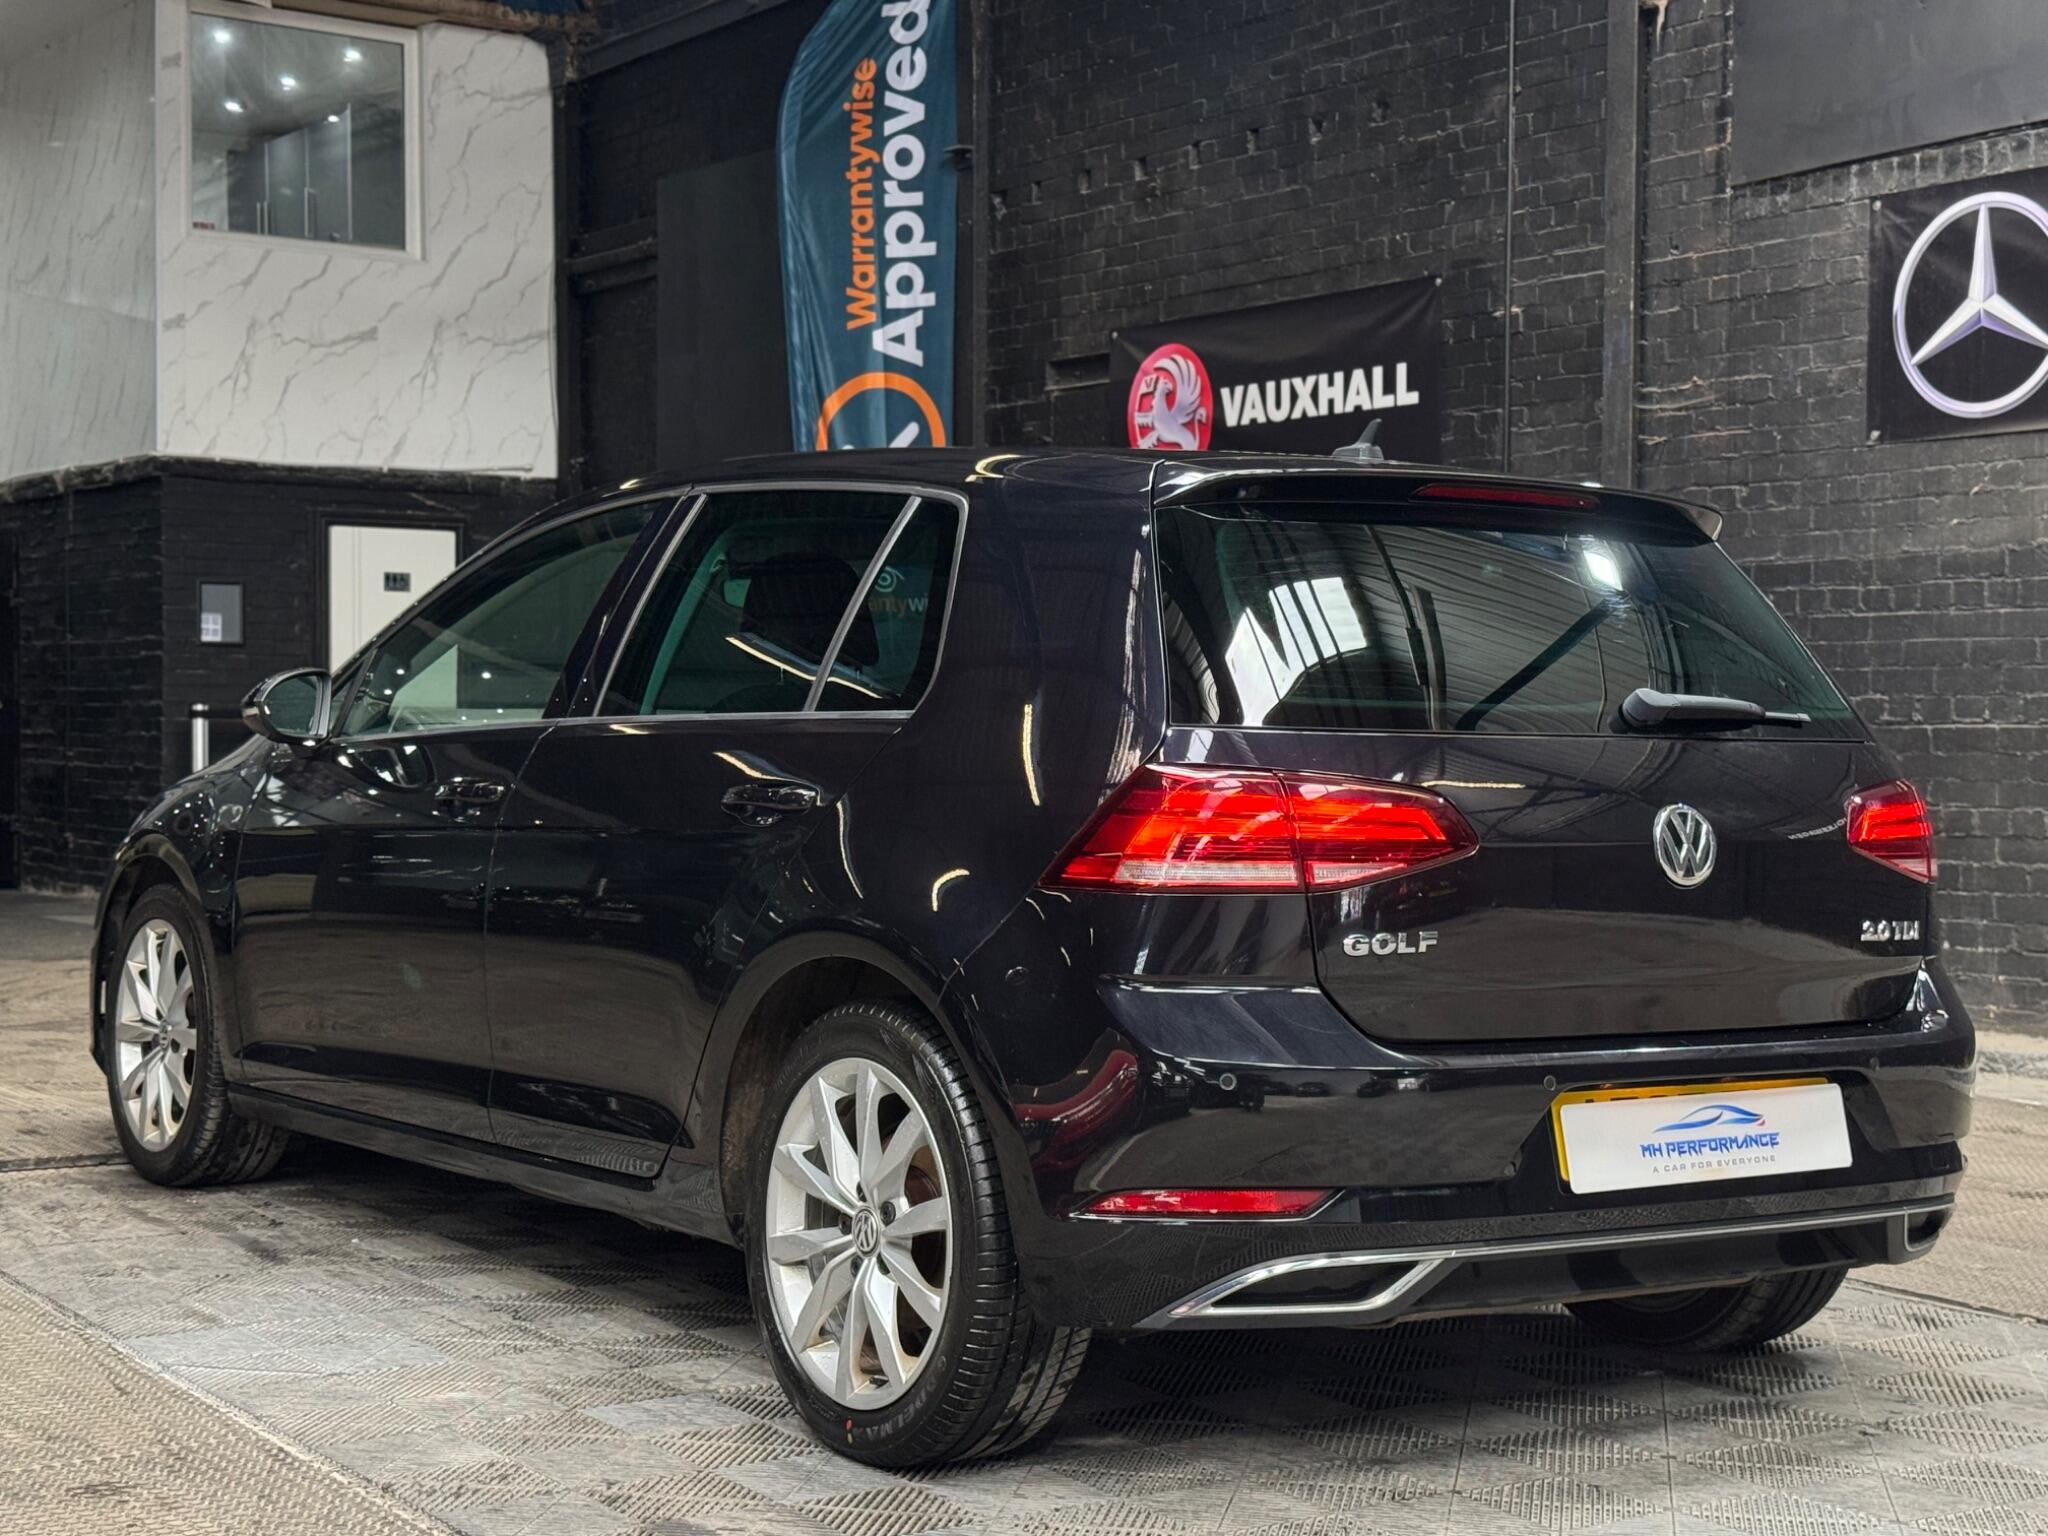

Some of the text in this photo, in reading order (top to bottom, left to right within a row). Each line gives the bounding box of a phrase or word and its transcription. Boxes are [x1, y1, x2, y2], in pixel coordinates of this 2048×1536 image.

[844, 57, 880, 330] Warrantywise
[872, 0, 937, 367] Approved
[1220, 362, 1419, 427] VAUXHALL
[1343, 931, 1438, 957] GOLF
[1640, 1132, 1780, 1159] MH PERFORMANCE
[1652, 1154, 1776, 1174] A CAR FOR EVERYONE
